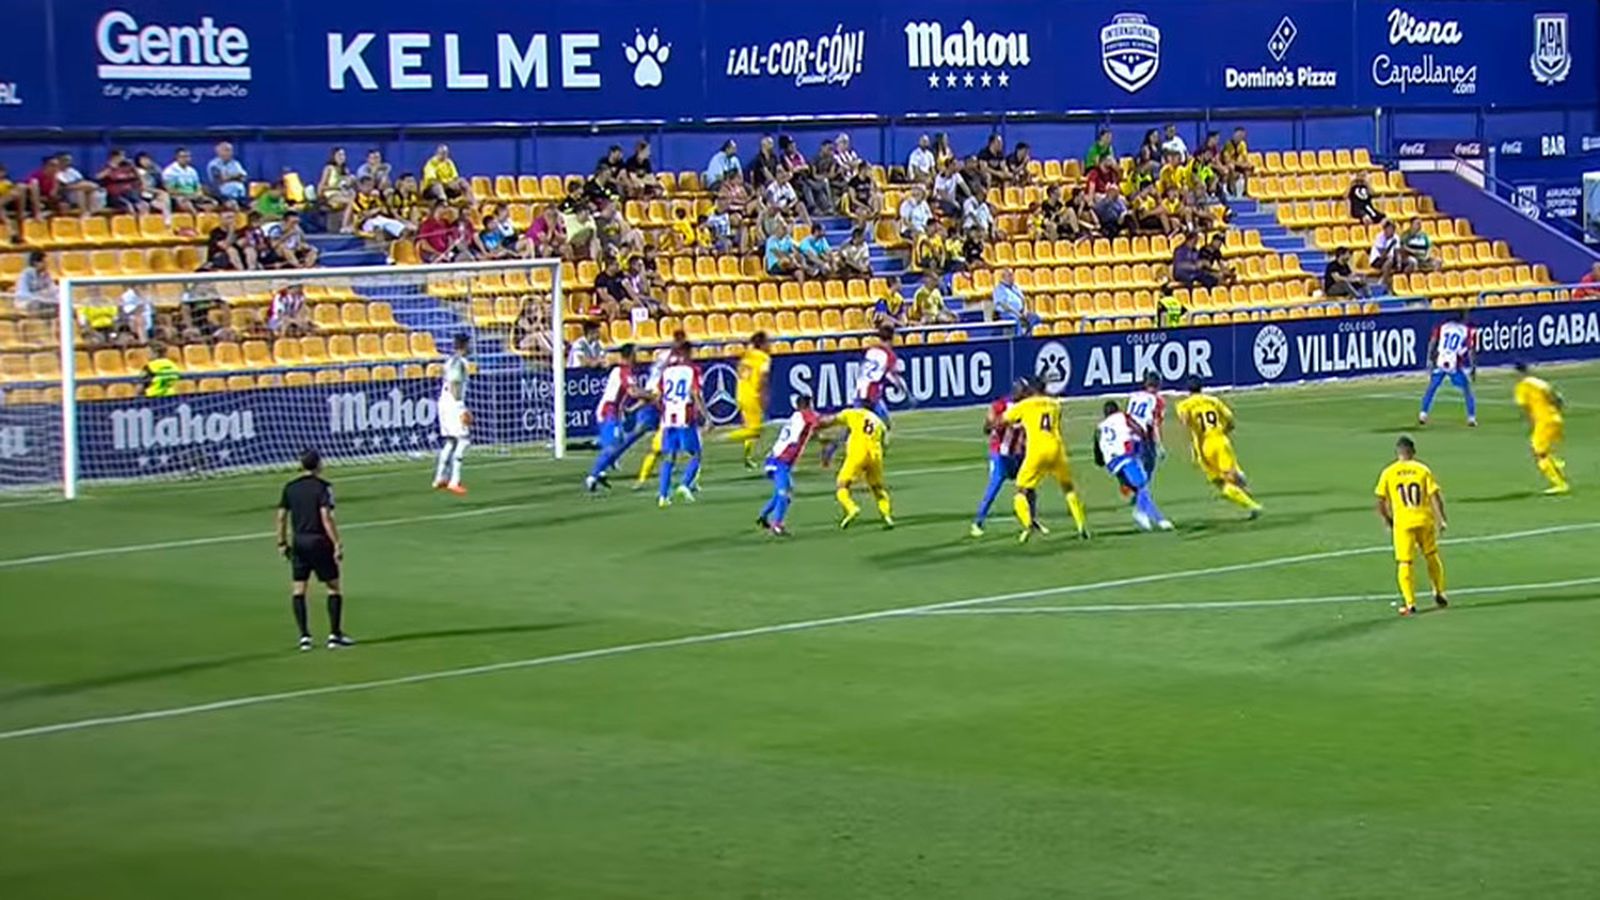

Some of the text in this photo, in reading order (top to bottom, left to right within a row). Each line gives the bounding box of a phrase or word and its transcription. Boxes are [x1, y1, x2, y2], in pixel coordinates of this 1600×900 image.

[97, 11, 249, 64] Gente
[904, 20, 1031, 67] Mahou
[1387, 8, 1462, 45] Viena
[327, 33, 601, 89] KELME
[1225, 66, 1337, 89] Domino's Pizza
[1372, 54, 1478, 94] Capellanes
[1541, 135, 1566, 156] BAR
[1126, 332, 1167, 345] COLEGIO
[1338, 320, 1376, 333] COLEGIO
[1443, 332, 1461, 351] 10
[1083, 339, 1214, 387] ALKOR
[1297, 328, 1416, 374] VILLALKOR
[664, 378, 687, 401] 24
[789, 350, 992, 410] SASUNG
[111, 404, 256, 450] Mahou
[327, 387, 438, 432] Maho
[1040, 412, 1052, 432] 4
[1199, 410, 1218, 432] 19
[1396, 482, 1421, 508] 10
